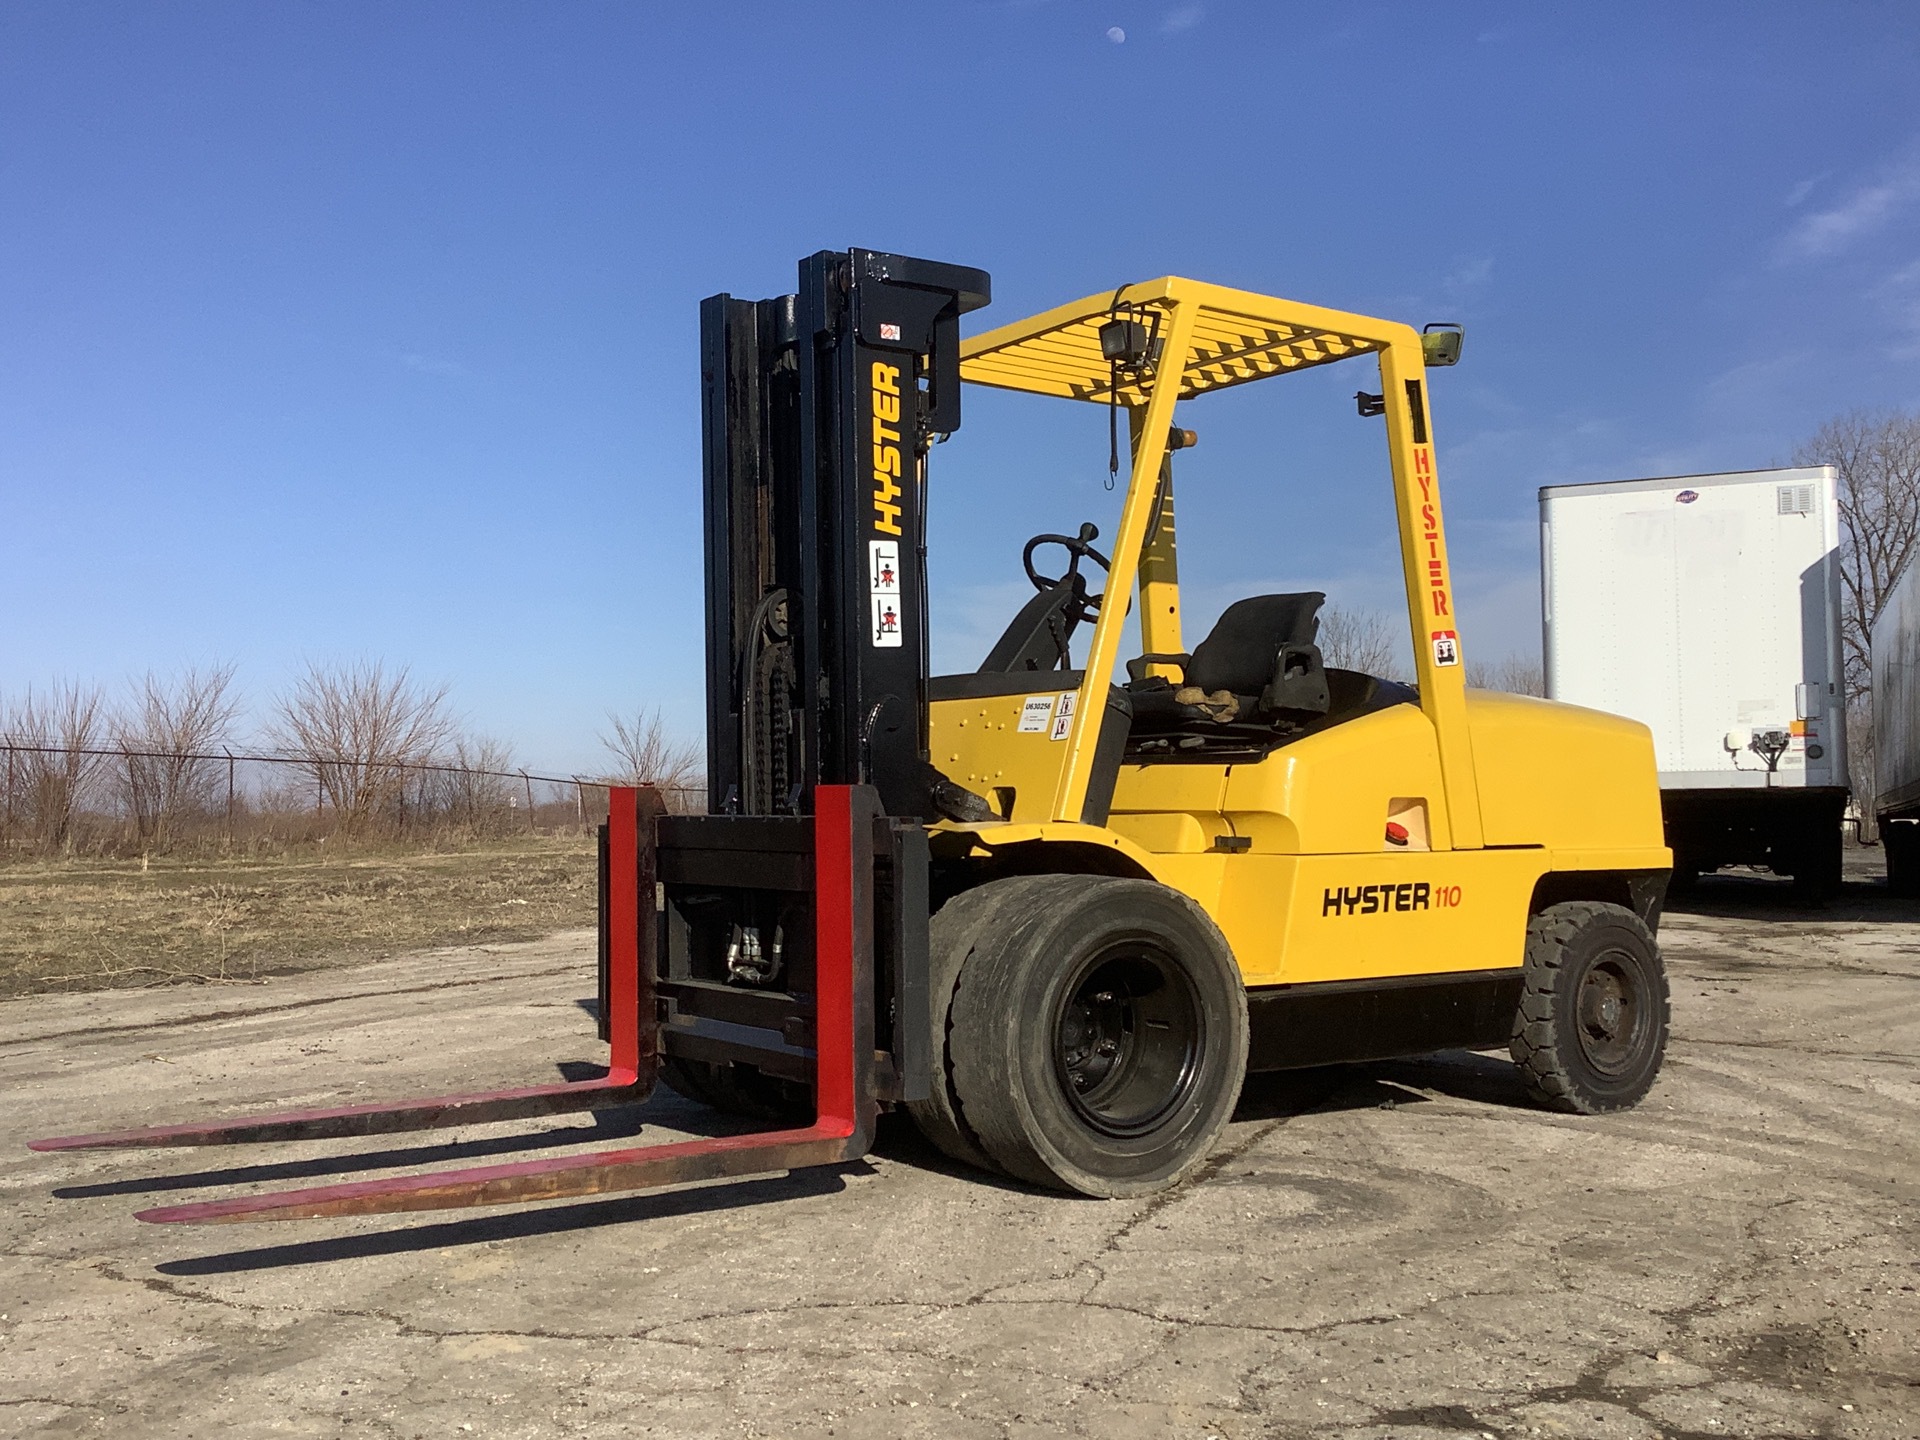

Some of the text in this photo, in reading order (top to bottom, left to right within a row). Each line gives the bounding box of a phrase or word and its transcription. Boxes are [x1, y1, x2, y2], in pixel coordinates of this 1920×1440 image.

[872, 362, 902, 536] HYSTER
[1413, 448, 1449, 616] HYSTER
[1025, 702, 1051, 710] U630256
[1322, 882, 1462, 917] HYSTER 110
